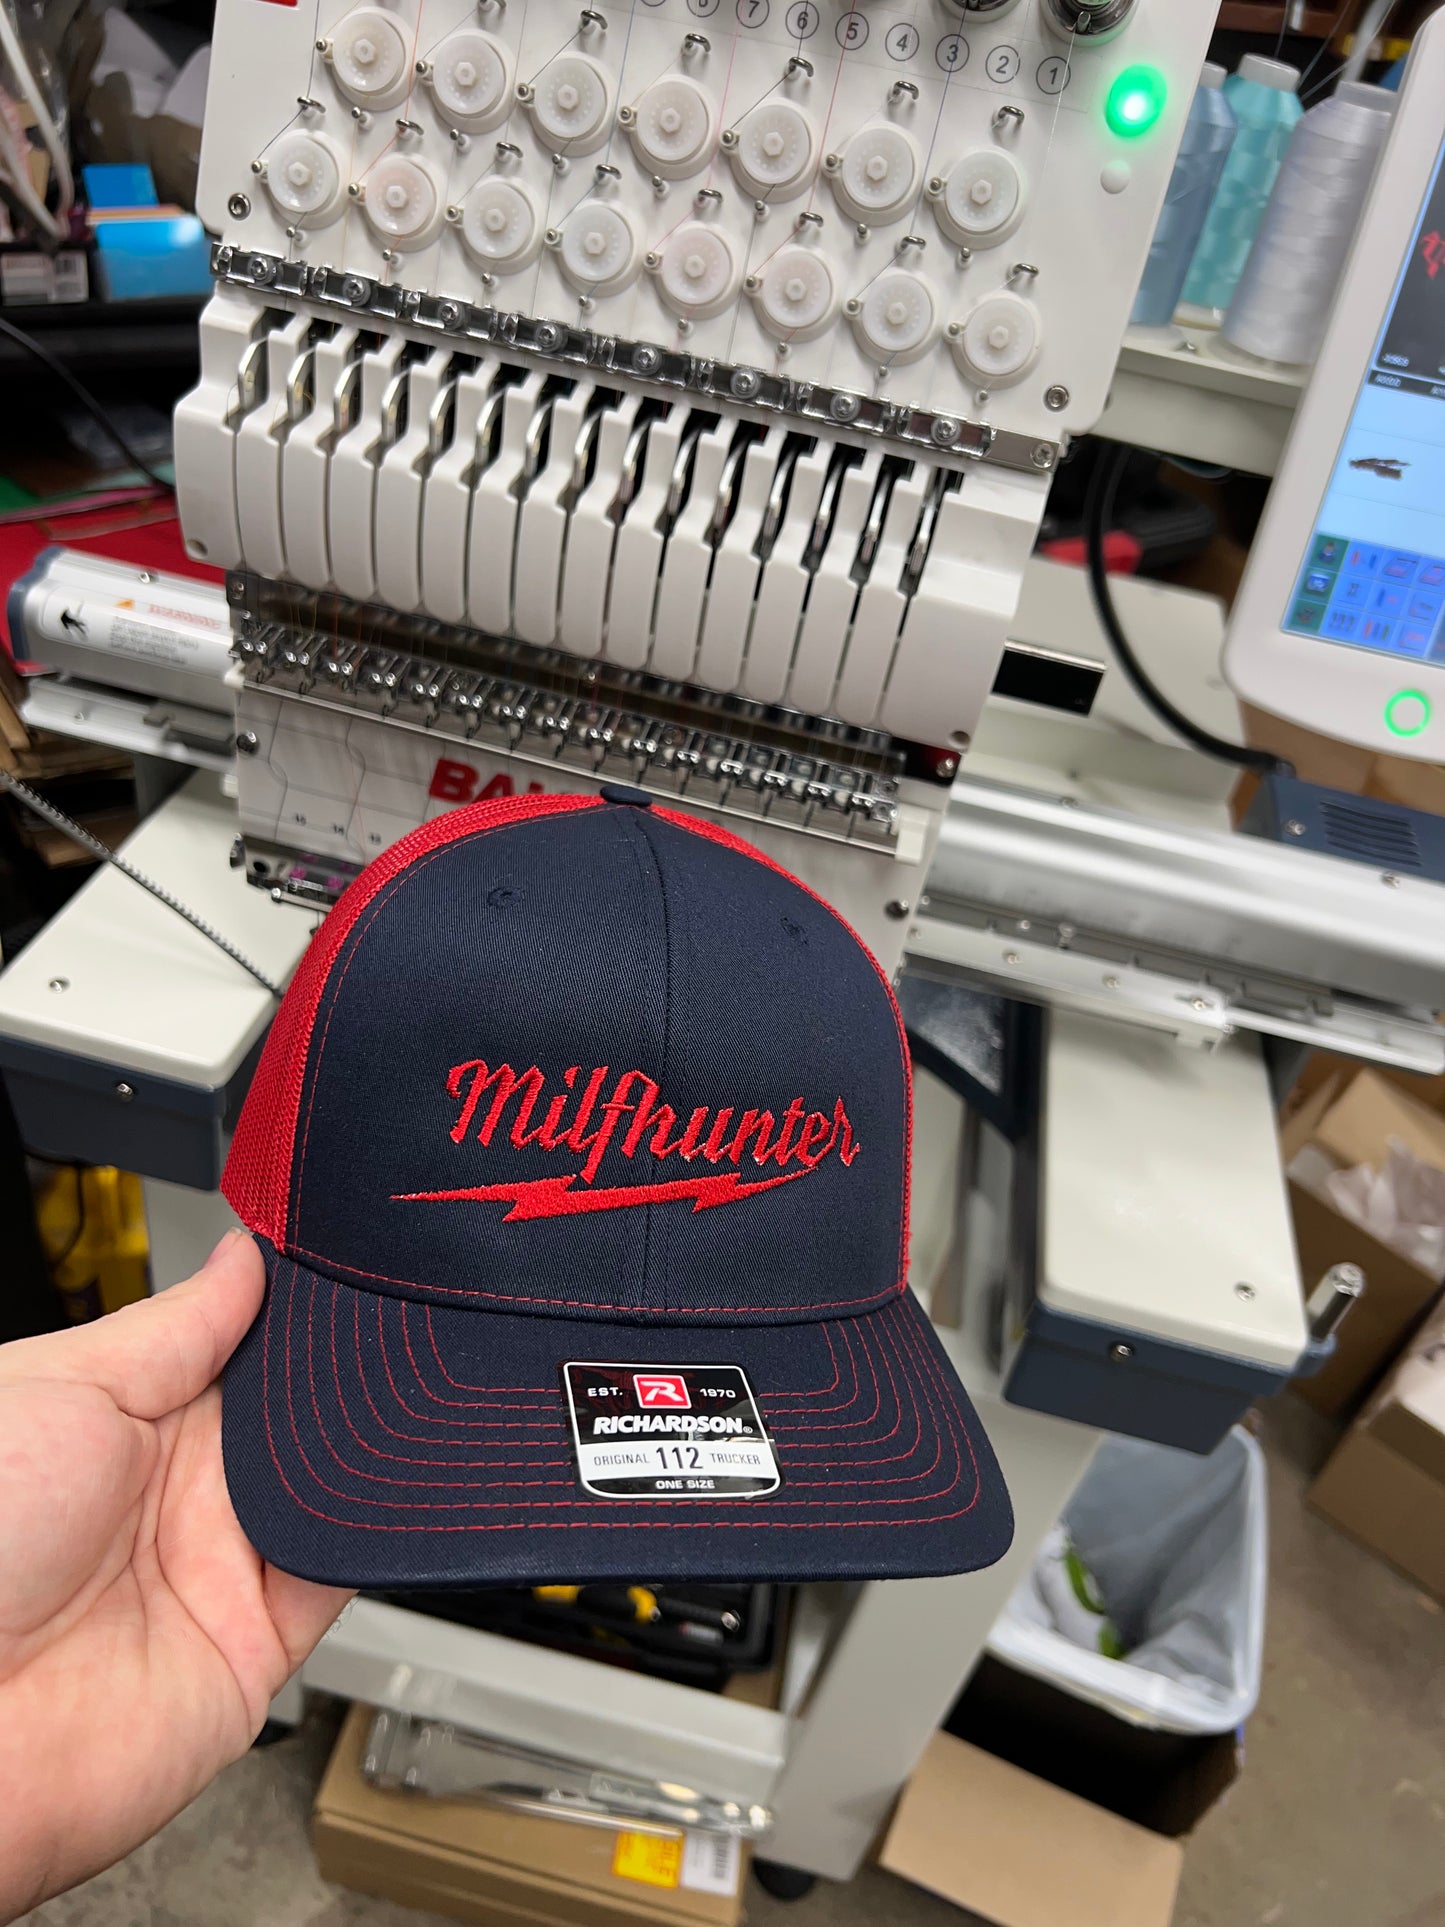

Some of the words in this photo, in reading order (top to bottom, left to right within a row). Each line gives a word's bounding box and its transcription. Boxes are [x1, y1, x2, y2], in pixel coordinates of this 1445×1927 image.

[748, 0, 760, 18] 7
[797, 12, 808, 29] 6
[846, 23, 858, 40] 5
[897, 34, 908, 51] 4
[947, 45, 958, 62] 3
[997, 56, 1009, 74] 2
[446, 1058, 860, 1185] Milfhunter
[588, 1387, 623, 1397] EST.
[700, 1388, 736, 1398] 1970
[594, 1453, 650, 1466] ORIGINAL
[656, 1447, 703, 1469] 112
[710, 1453, 760, 1465] TRUCKER
[655, 1480, 683, 1489] ONE
[687, 1480, 715, 1489] SIZE
